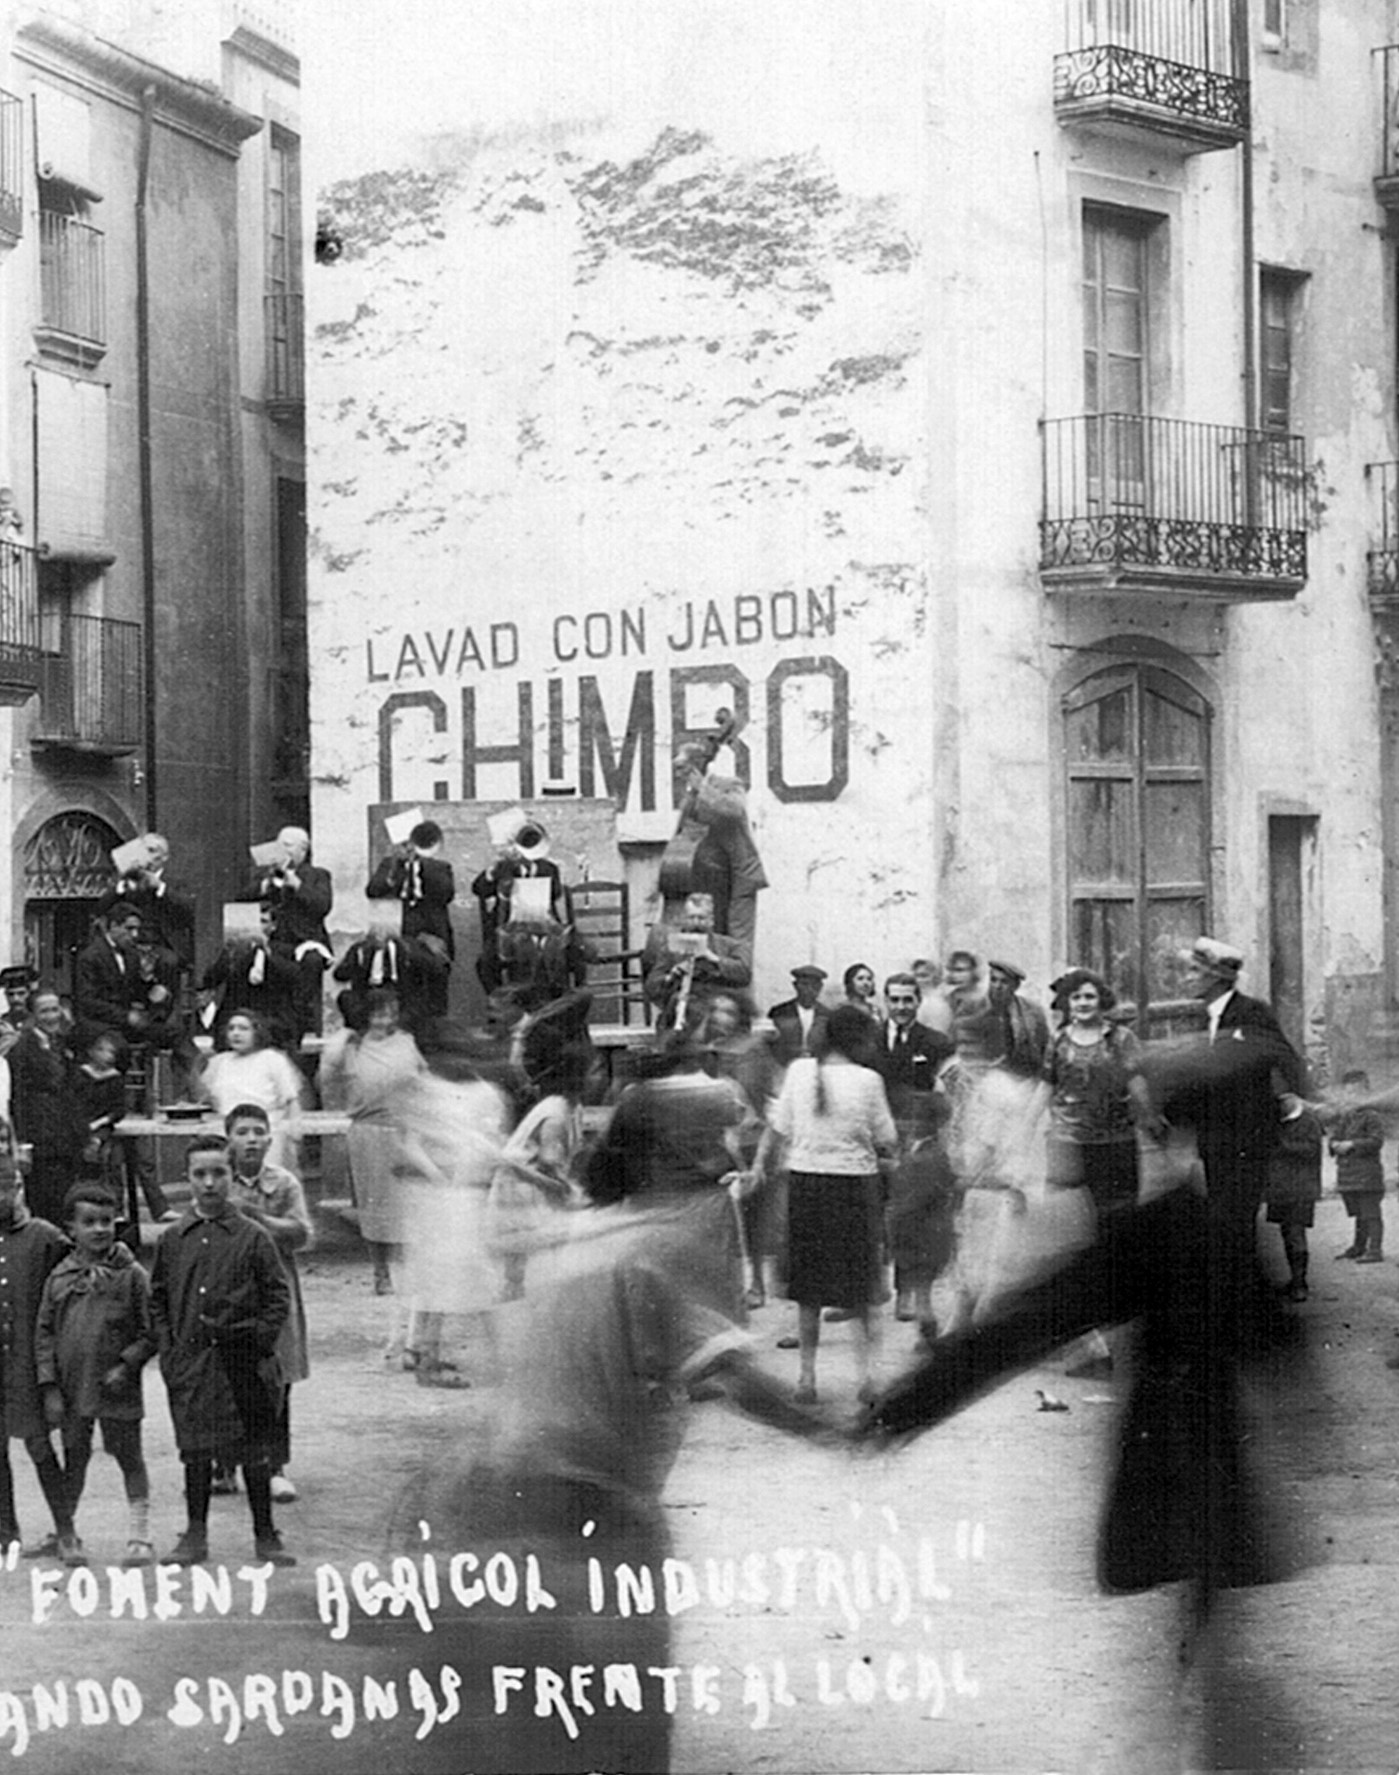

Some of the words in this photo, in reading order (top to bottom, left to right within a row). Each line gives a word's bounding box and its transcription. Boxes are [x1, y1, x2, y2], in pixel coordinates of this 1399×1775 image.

[366, 622, 519, 683] LAVAD
[552, 607, 647, 663] CON
[667, 586, 837, 652] JABON
[378, 655, 850, 813] CHIMBO
